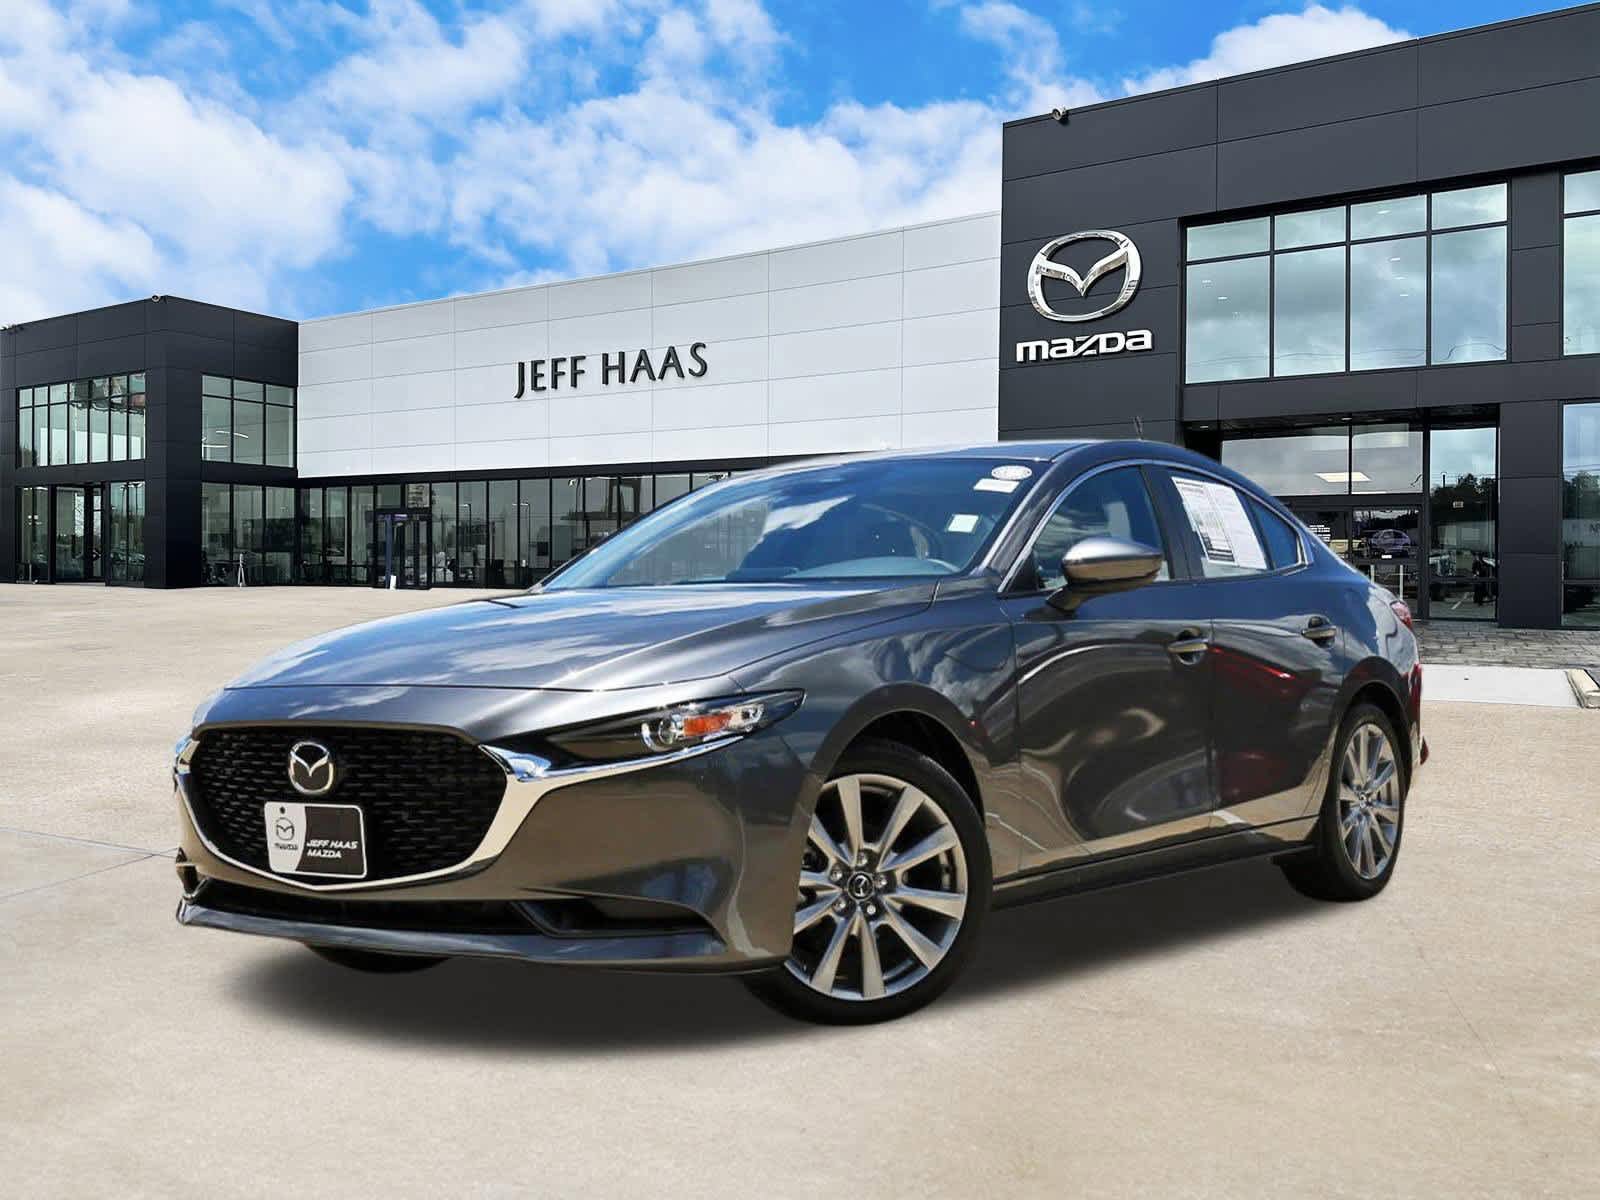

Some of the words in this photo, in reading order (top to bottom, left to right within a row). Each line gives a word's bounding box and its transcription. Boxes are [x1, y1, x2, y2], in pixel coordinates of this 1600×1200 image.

[514, 355, 586, 399] JEFF
[602, 342, 708, 385] HAAS
[306, 839, 330, 848] JEFF
[330, 840, 359, 850] HAAS
[306, 849, 342, 858] MAZDA
